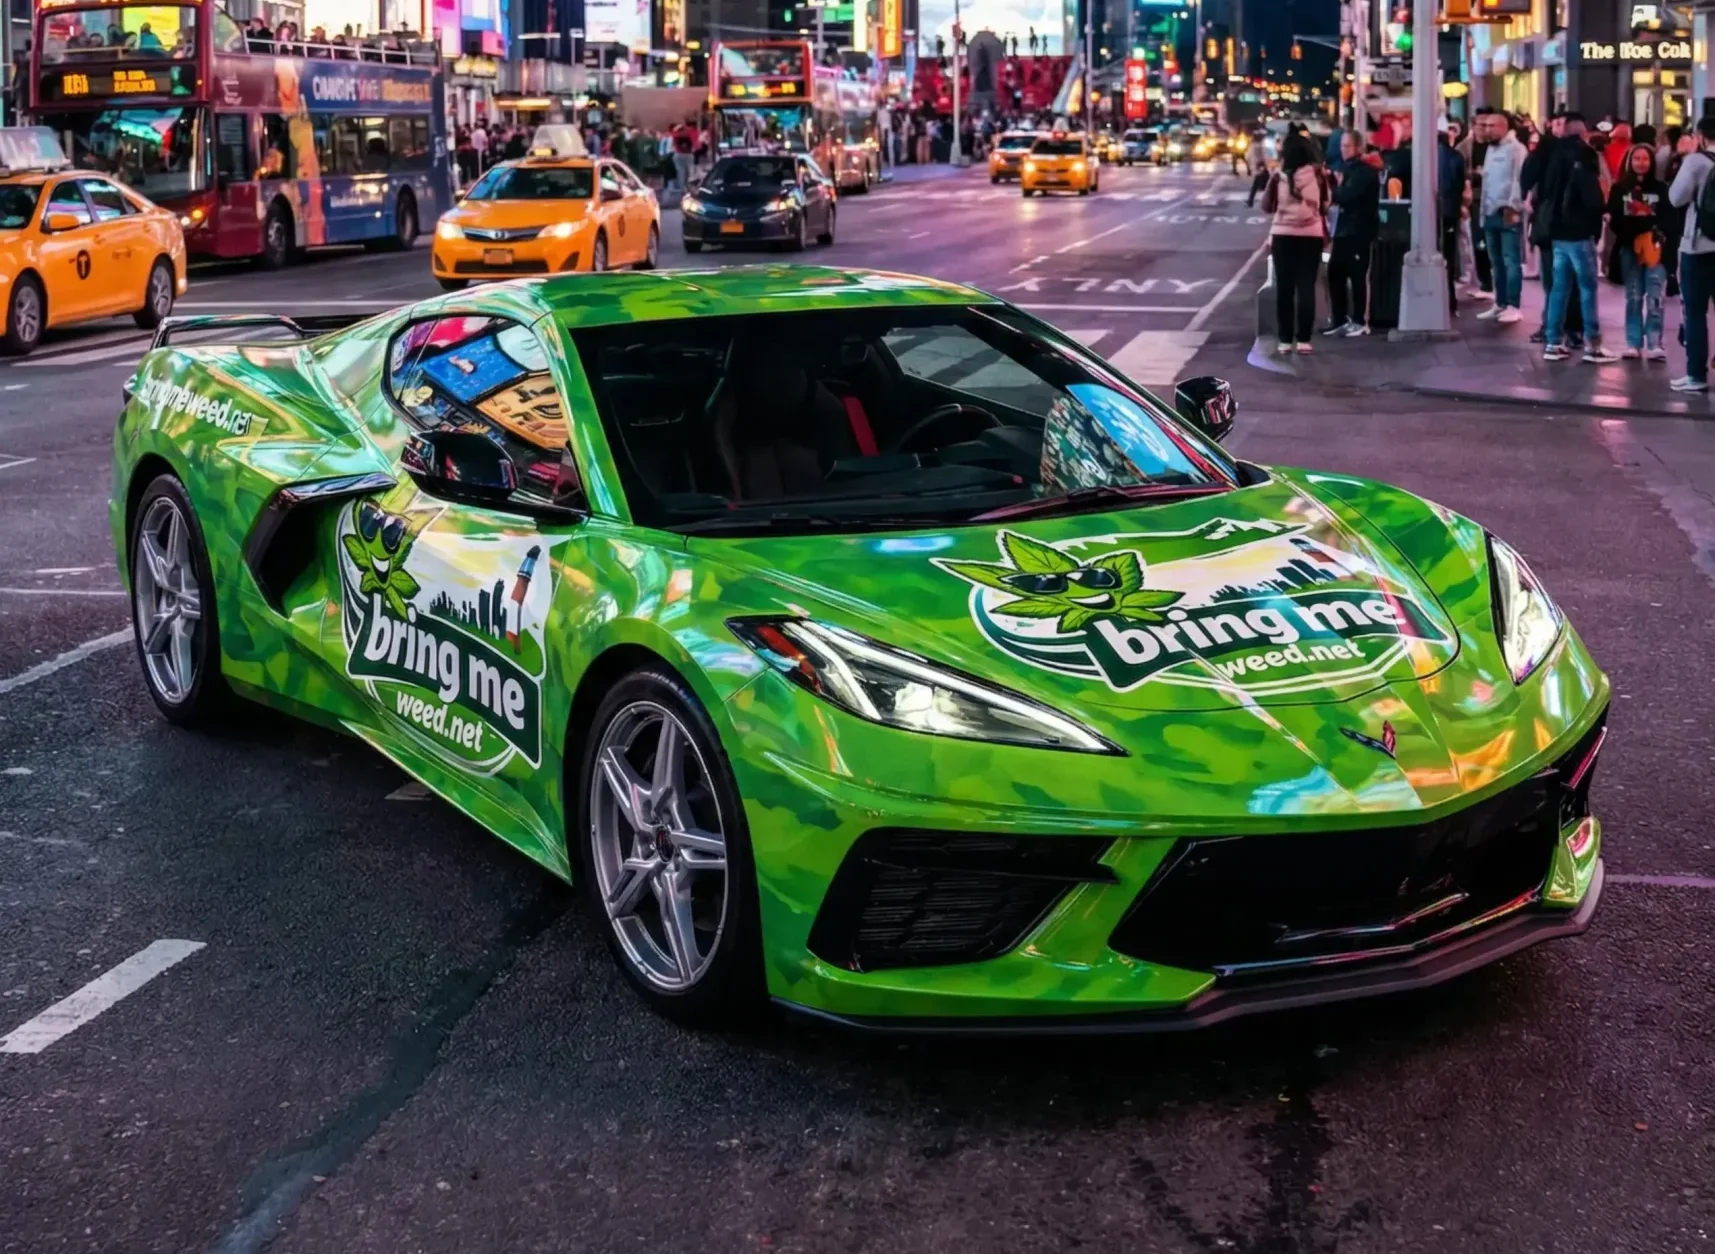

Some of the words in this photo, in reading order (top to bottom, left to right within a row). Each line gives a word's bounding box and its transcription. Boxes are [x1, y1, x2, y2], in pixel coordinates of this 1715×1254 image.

[1580, 42, 1615, 59] The
[364, 593, 460, 703] bring
[469, 654, 525, 729] me
[1094, 607, 1300, 664] bring
[1297, 599, 1406, 631] me
[1216, 638, 1366, 679] weed.net
[397, 691, 482, 752] weed.net
